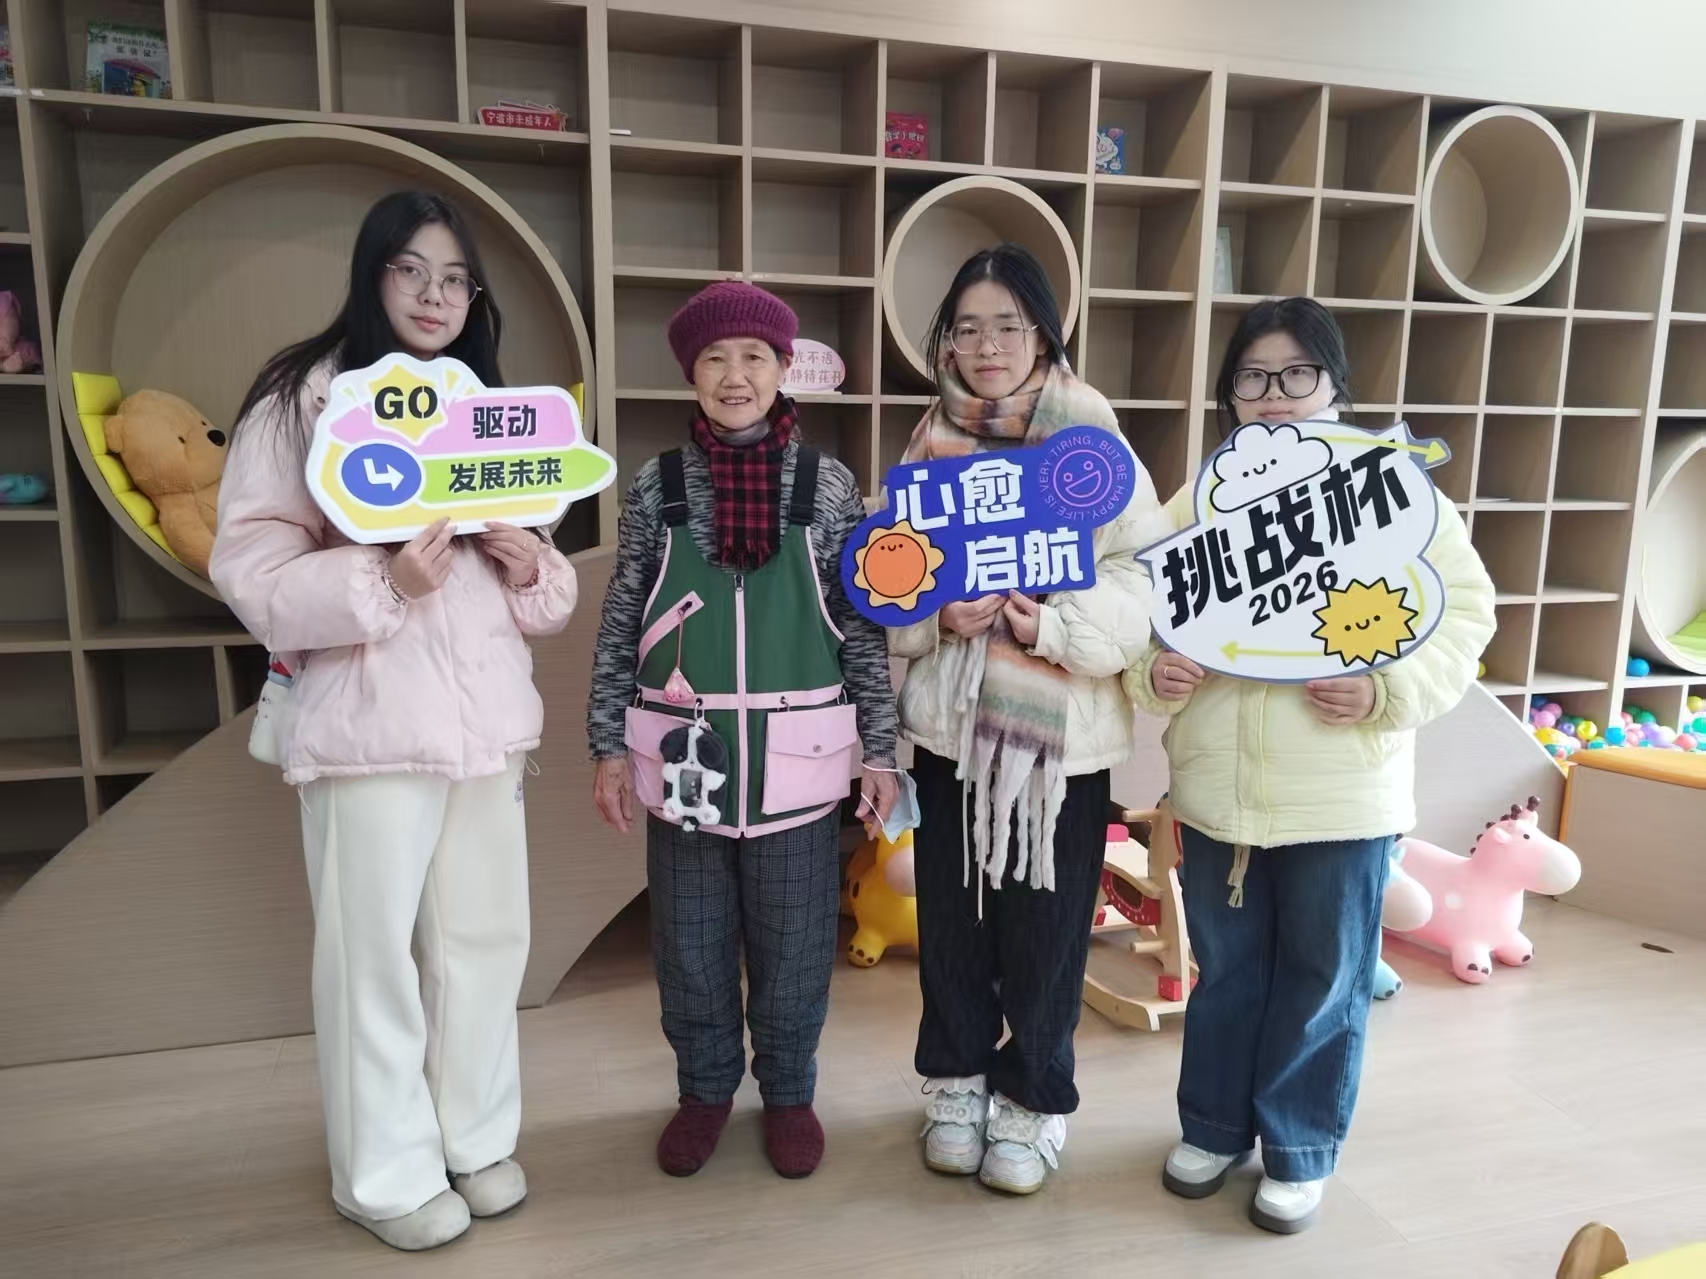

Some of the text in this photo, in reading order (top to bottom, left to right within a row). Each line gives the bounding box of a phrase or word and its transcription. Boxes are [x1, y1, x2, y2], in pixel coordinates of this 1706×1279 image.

[374, 385, 438, 420] GO
[472, 404, 537, 440] 驱动
[1098, 440, 1122, 460] BUT
[448, 457, 562, 494] 发展未来
[1039, 458, 1053, 493] VERY
[1116, 464, 1128, 480] BE
[895, 458, 1026, 531] 心愈
[1045, 495, 1057, 509] IS
[1056, 505, 1084, 521] LIFE
[1162, 438, 1411, 630] 挑战杯
[965, 526, 1084, 594] 启航
[1248, 560, 1339, 627] 2026
